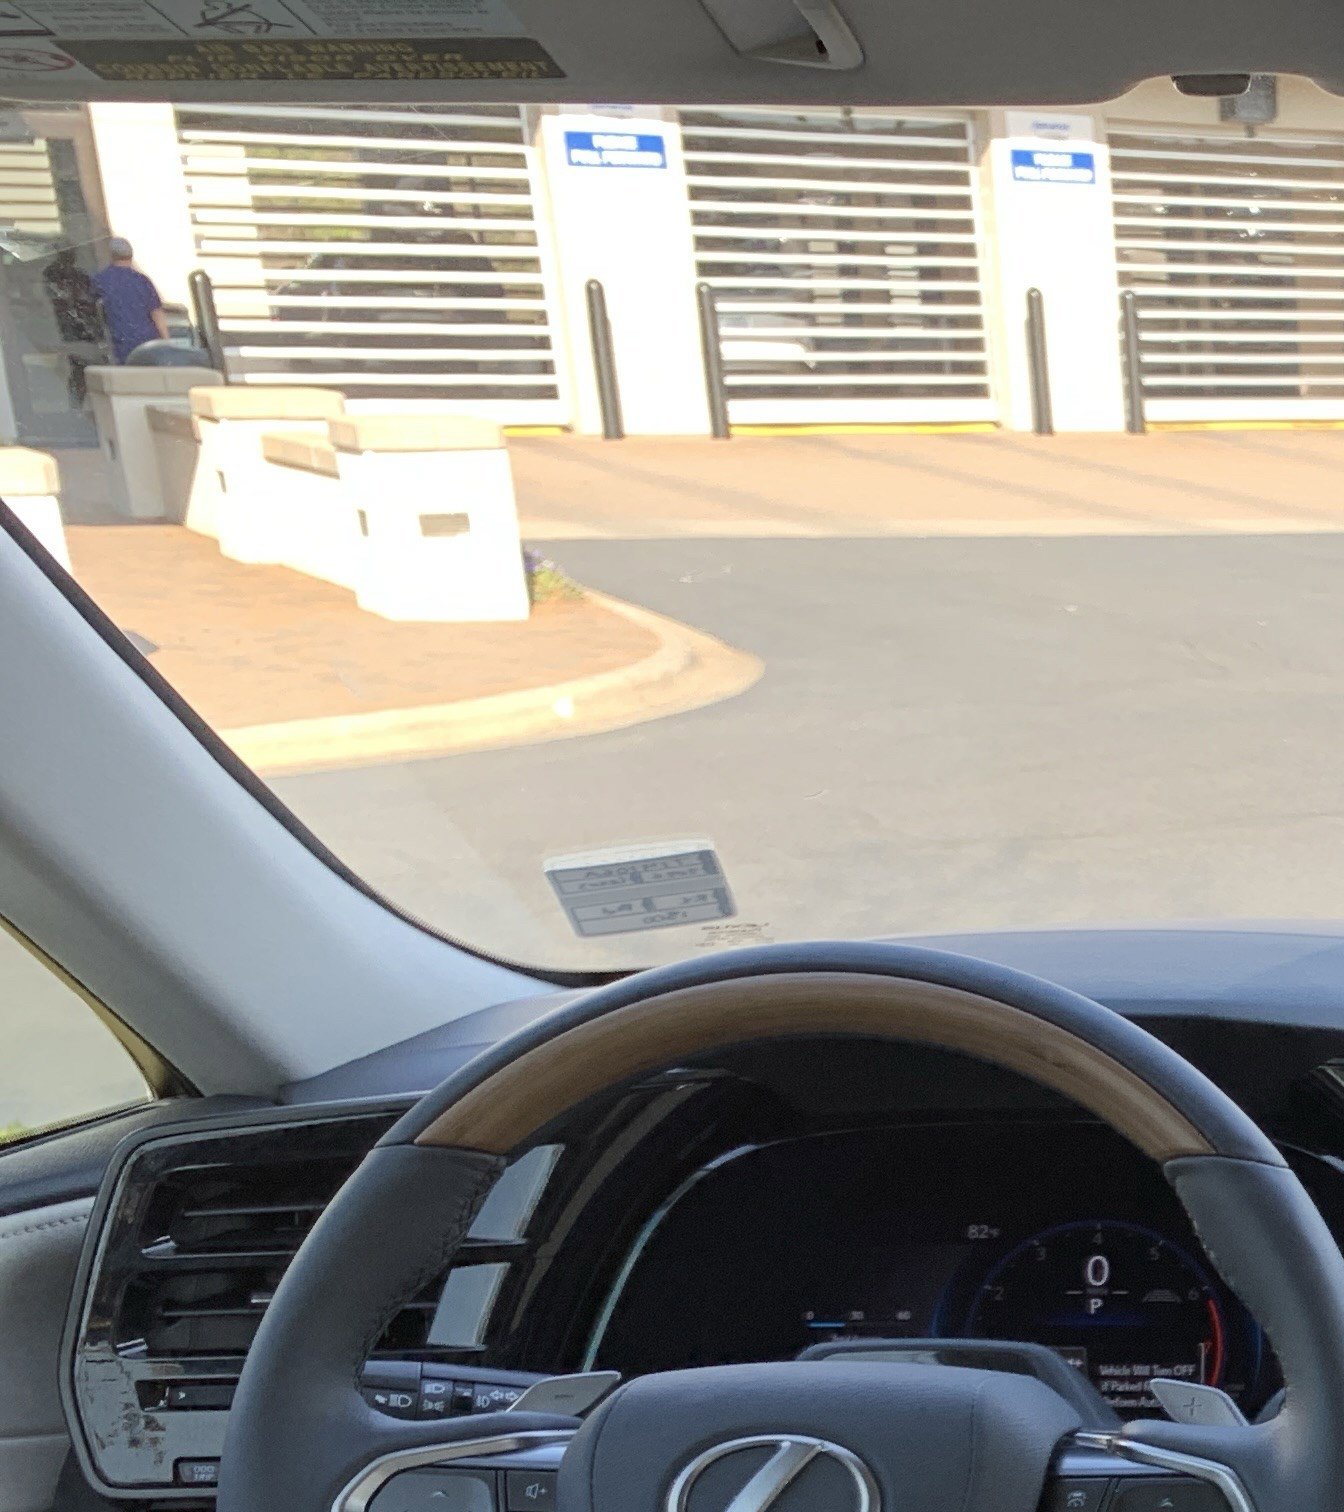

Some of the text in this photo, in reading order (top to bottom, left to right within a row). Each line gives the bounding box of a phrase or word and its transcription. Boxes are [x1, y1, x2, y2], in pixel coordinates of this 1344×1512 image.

[1086, 1255, 1110, 1286] 0
[1090, 1298, 1103, 1314] P
[1173, 1364, 1196, 1377] OFF
